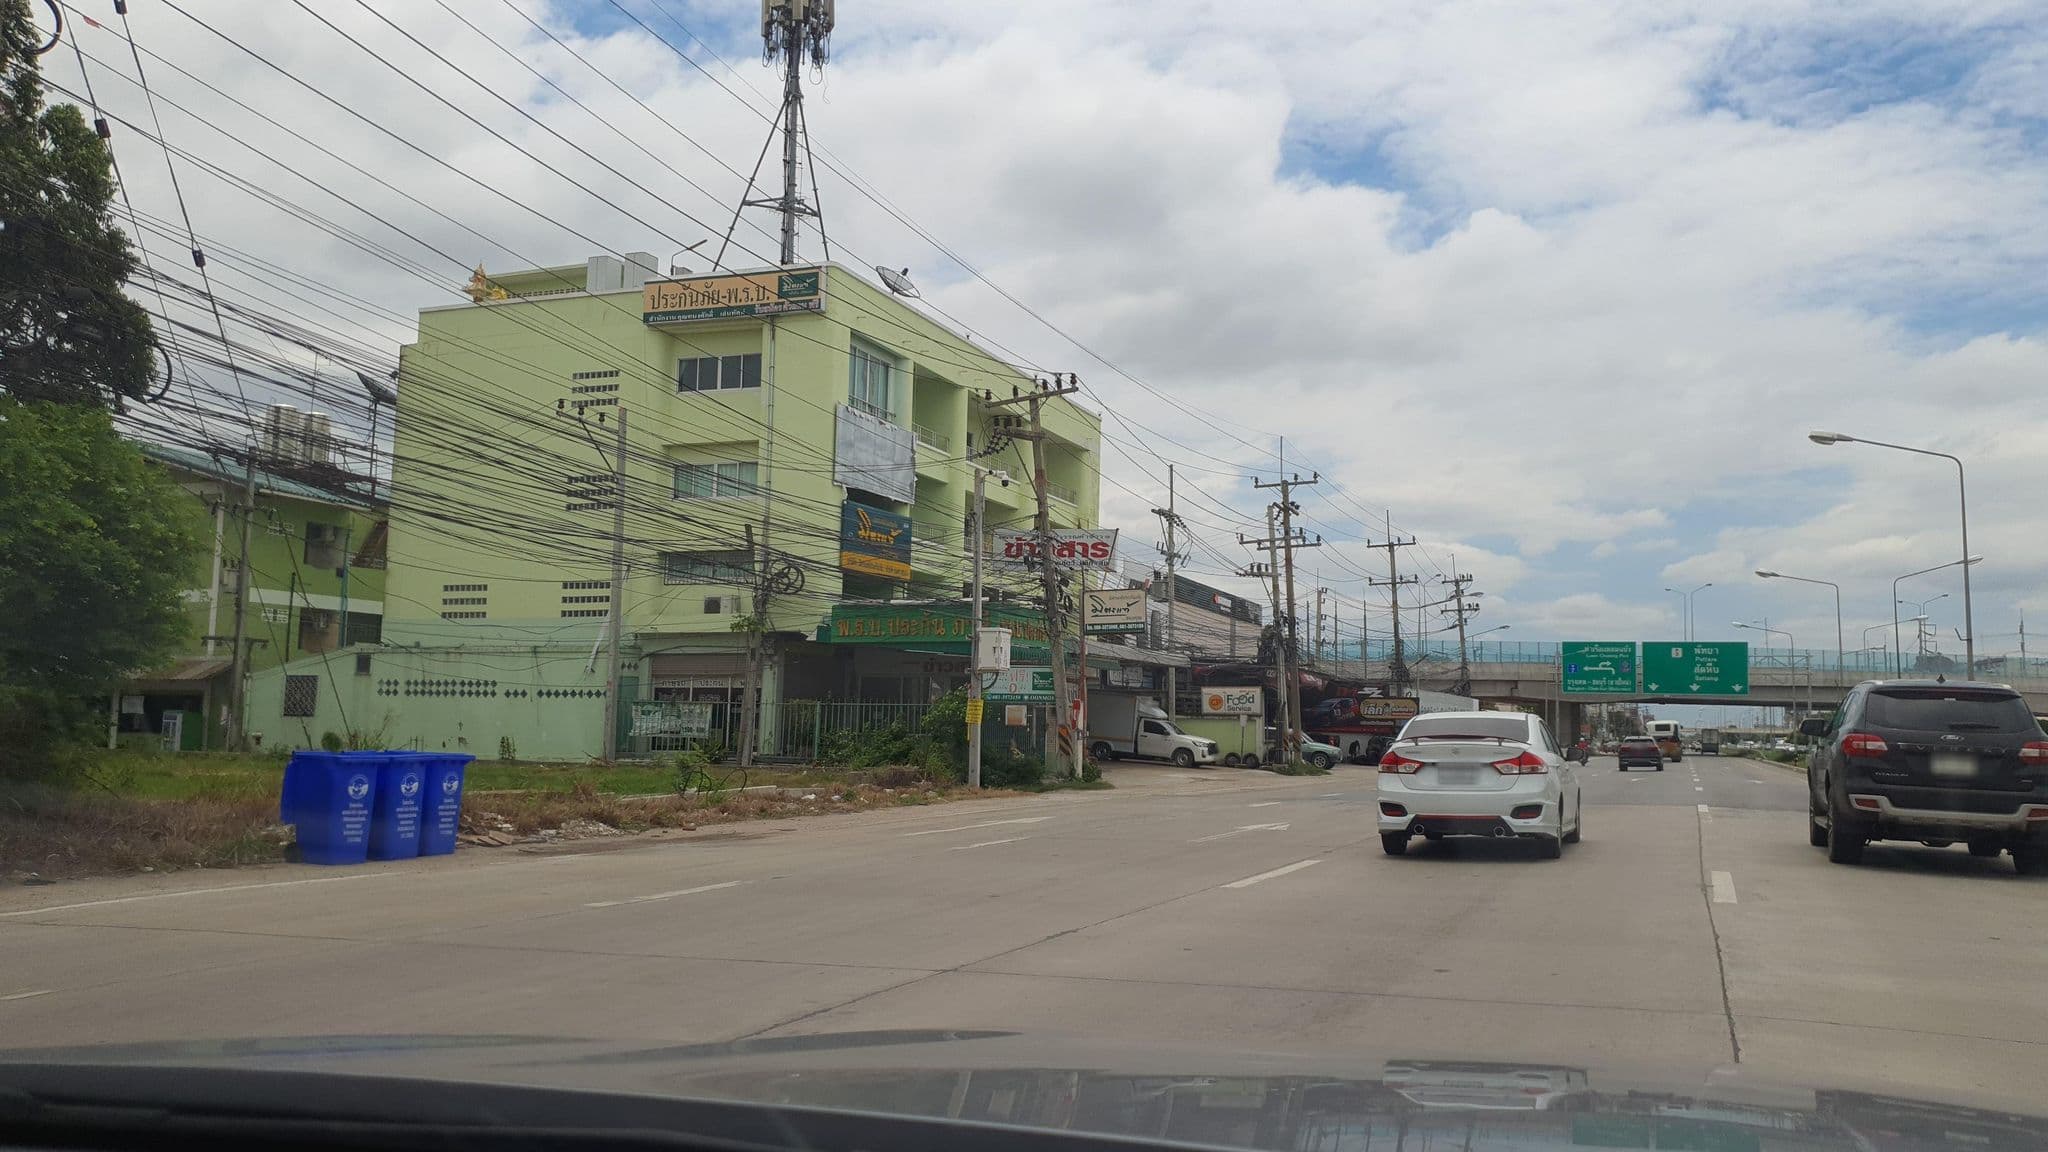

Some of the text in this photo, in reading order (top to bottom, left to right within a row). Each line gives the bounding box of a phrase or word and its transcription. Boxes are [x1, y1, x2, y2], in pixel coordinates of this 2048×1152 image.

[1004, 536, 1110, 559] ข้าสาร
[1227, 692, 1254, 705] Food
